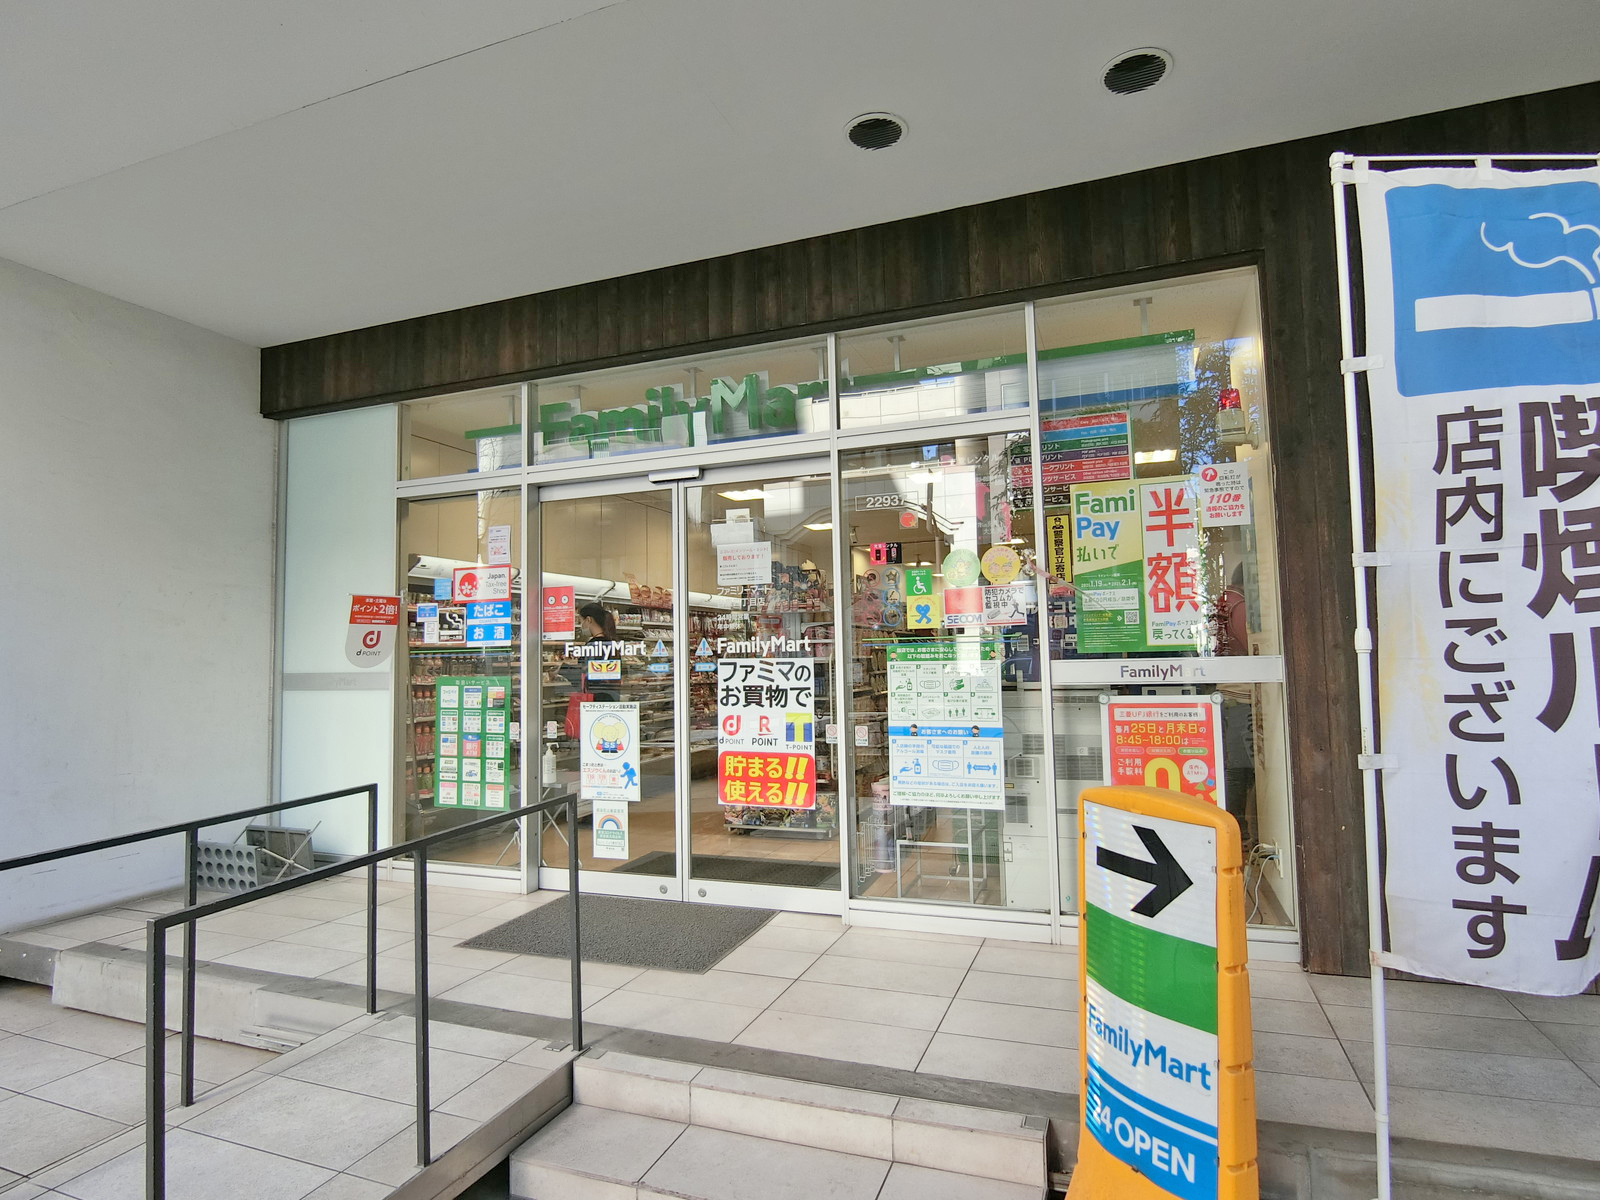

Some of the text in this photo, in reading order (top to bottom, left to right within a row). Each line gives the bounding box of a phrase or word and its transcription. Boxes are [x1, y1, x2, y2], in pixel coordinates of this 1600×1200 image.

[539, 373, 853, 452] FamilyMar
[865, 495, 906, 509] 22937
[1075, 488, 1136, 515] Fami
[1209, 493, 1242, 504] 110番
[1076, 517, 1120, 541] Pay
[1053, 530, 1066, 581] 警察官立寄店
[1076, 545, 1119, 563] 払いで
[1146, 488, 1200, 614] 半額
[716, 585, 771, 595] ファミリーマート
[985, 587, 1024, 597] 防犯カメラで
[352, 604, 398, 615] ポイント2倍!
[473, 604, 504, 617] たばこ
[985, 602, 1008, 610] 監視中
[947, 614, 982, 625] SECOM
[564, 640, 646, 660] FamilyMart
[717, 635, 811, 657] FamilyMart
[719, 660, 812, 683] ファミマの
[1432, 406, 1528, 960] 店内にございます
[720, 685, 812, 708] お買物で
[1115, 723, 1206, 734] 毎月25日と月末日の
[752, 738, 779, 747] POINT
[724, 755, 809, 780] 貯まる!!
[1117, 758, 1142, 767] ご利用
[1117, 767, 1143, 775] 手数料
[724, 780, 809, 806] 使える!!
[1088, 1003, 1211, 1091] FamilyMart
[1114, 1116, 1195, 1184] OPEN
